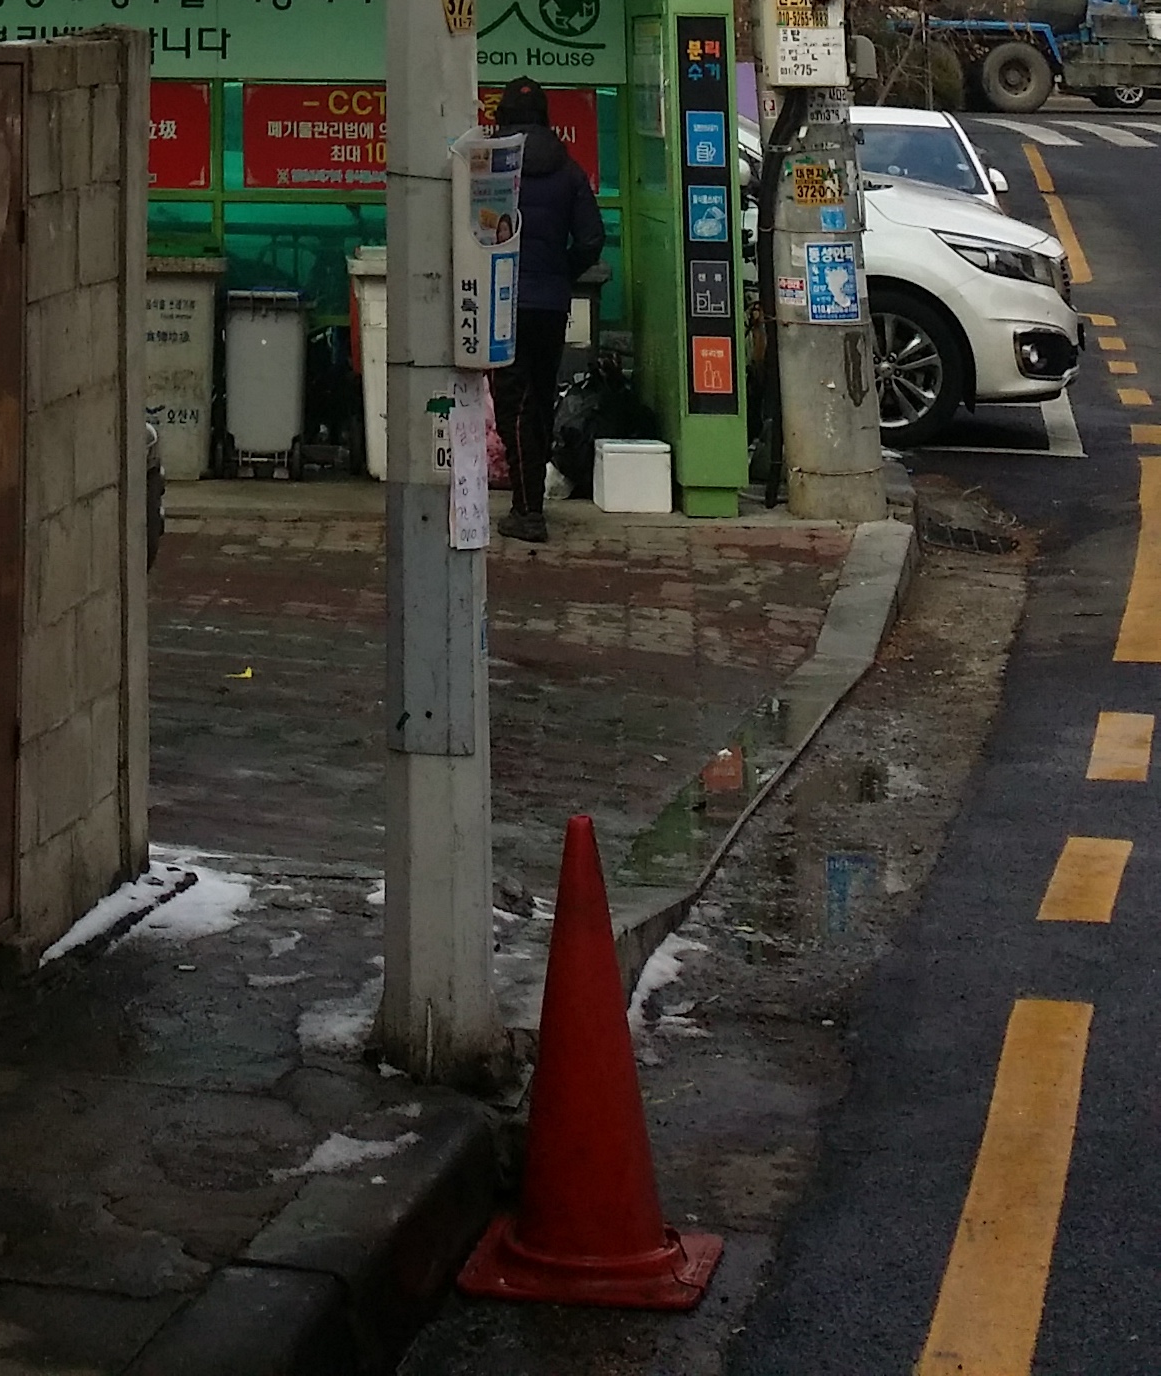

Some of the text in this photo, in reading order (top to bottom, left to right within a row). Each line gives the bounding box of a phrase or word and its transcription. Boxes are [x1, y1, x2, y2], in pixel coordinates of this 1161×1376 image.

[150, 26, 232, 65] 니다
[686, 39, 721, 61] 분리
[526, 47, 595, 67] House
[687, 63, 721, 81] 수거
[330, 144, 361, 162] 최대
[460, 279, 479, 354] 벼룩시장
[167, 408, 200, 425] 오산시
